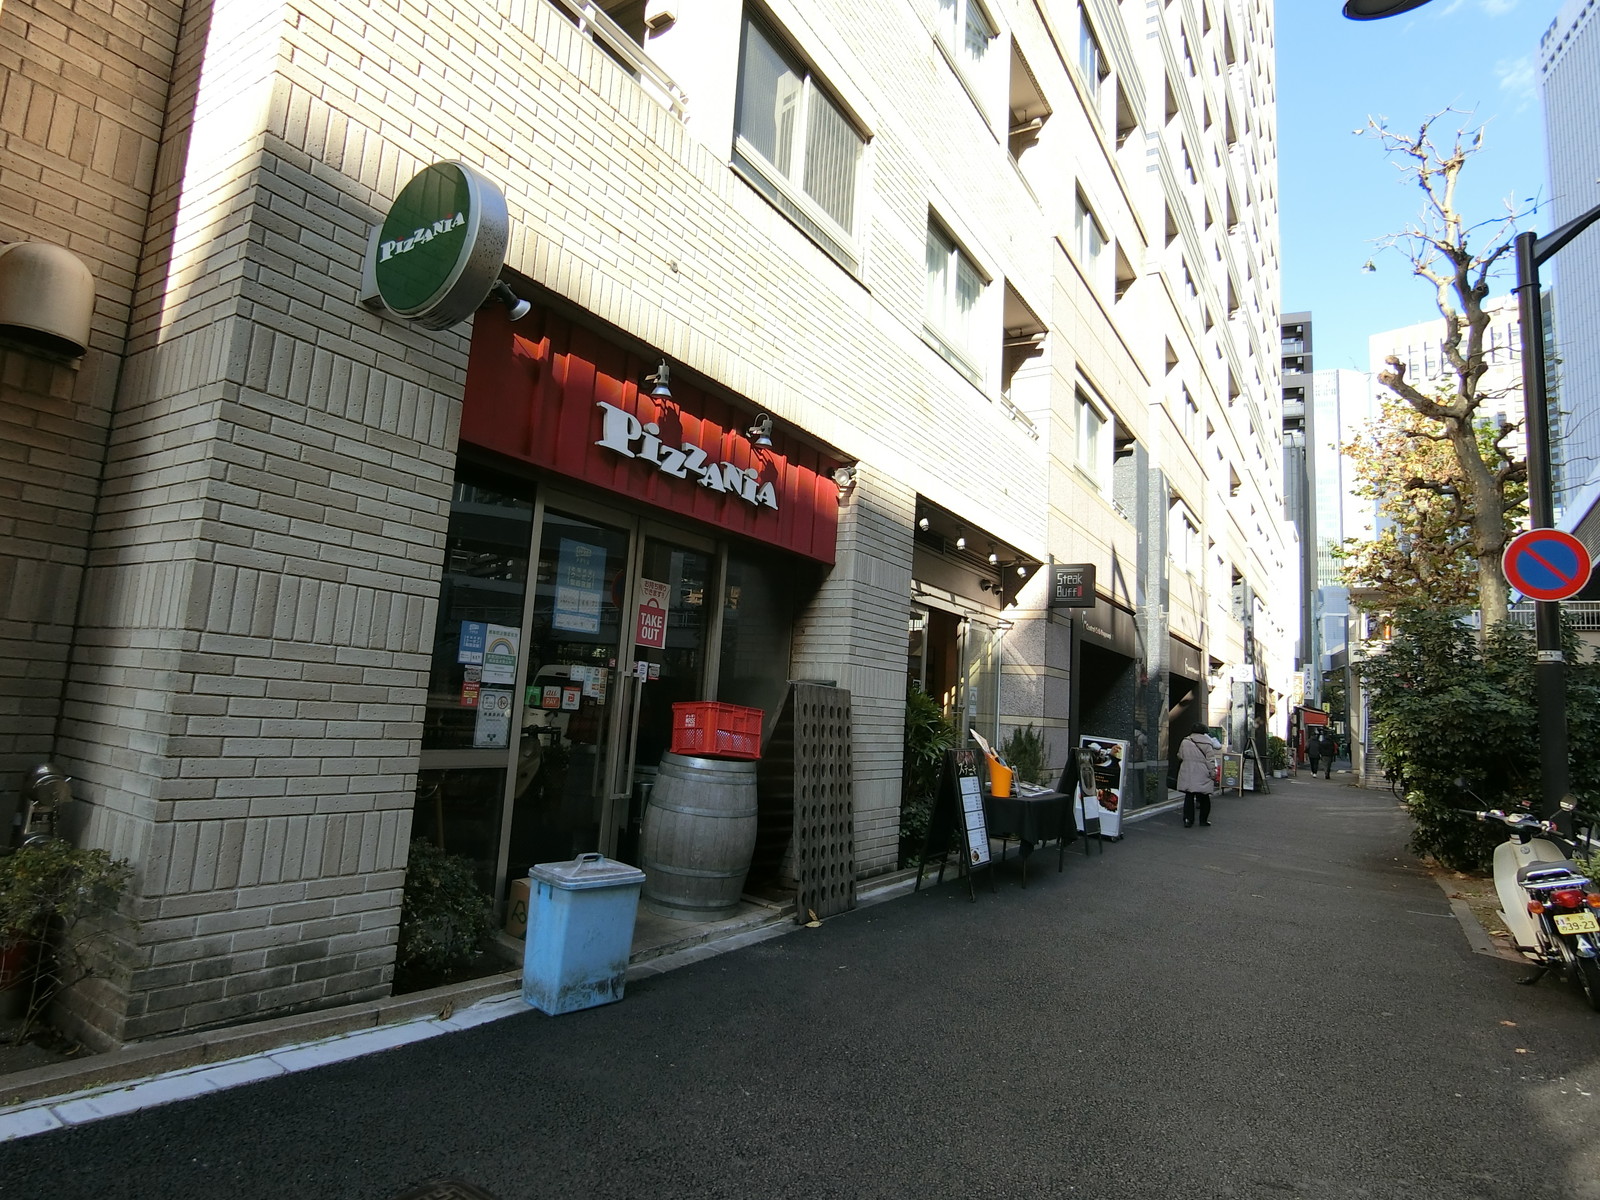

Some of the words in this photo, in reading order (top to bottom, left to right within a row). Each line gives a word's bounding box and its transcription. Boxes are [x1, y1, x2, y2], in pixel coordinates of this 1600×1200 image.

[1057, 573, 1083, 585] Steak
[640, 612, 663, 629] TAKE
[641, 626, 660, 641] OUT
[546, 689, 558, 697] au
[545, 697, 557, 705] PAY
[958, 763, 977, 776] ステーキ
[1566, 920, 1596, 931] 39-23
